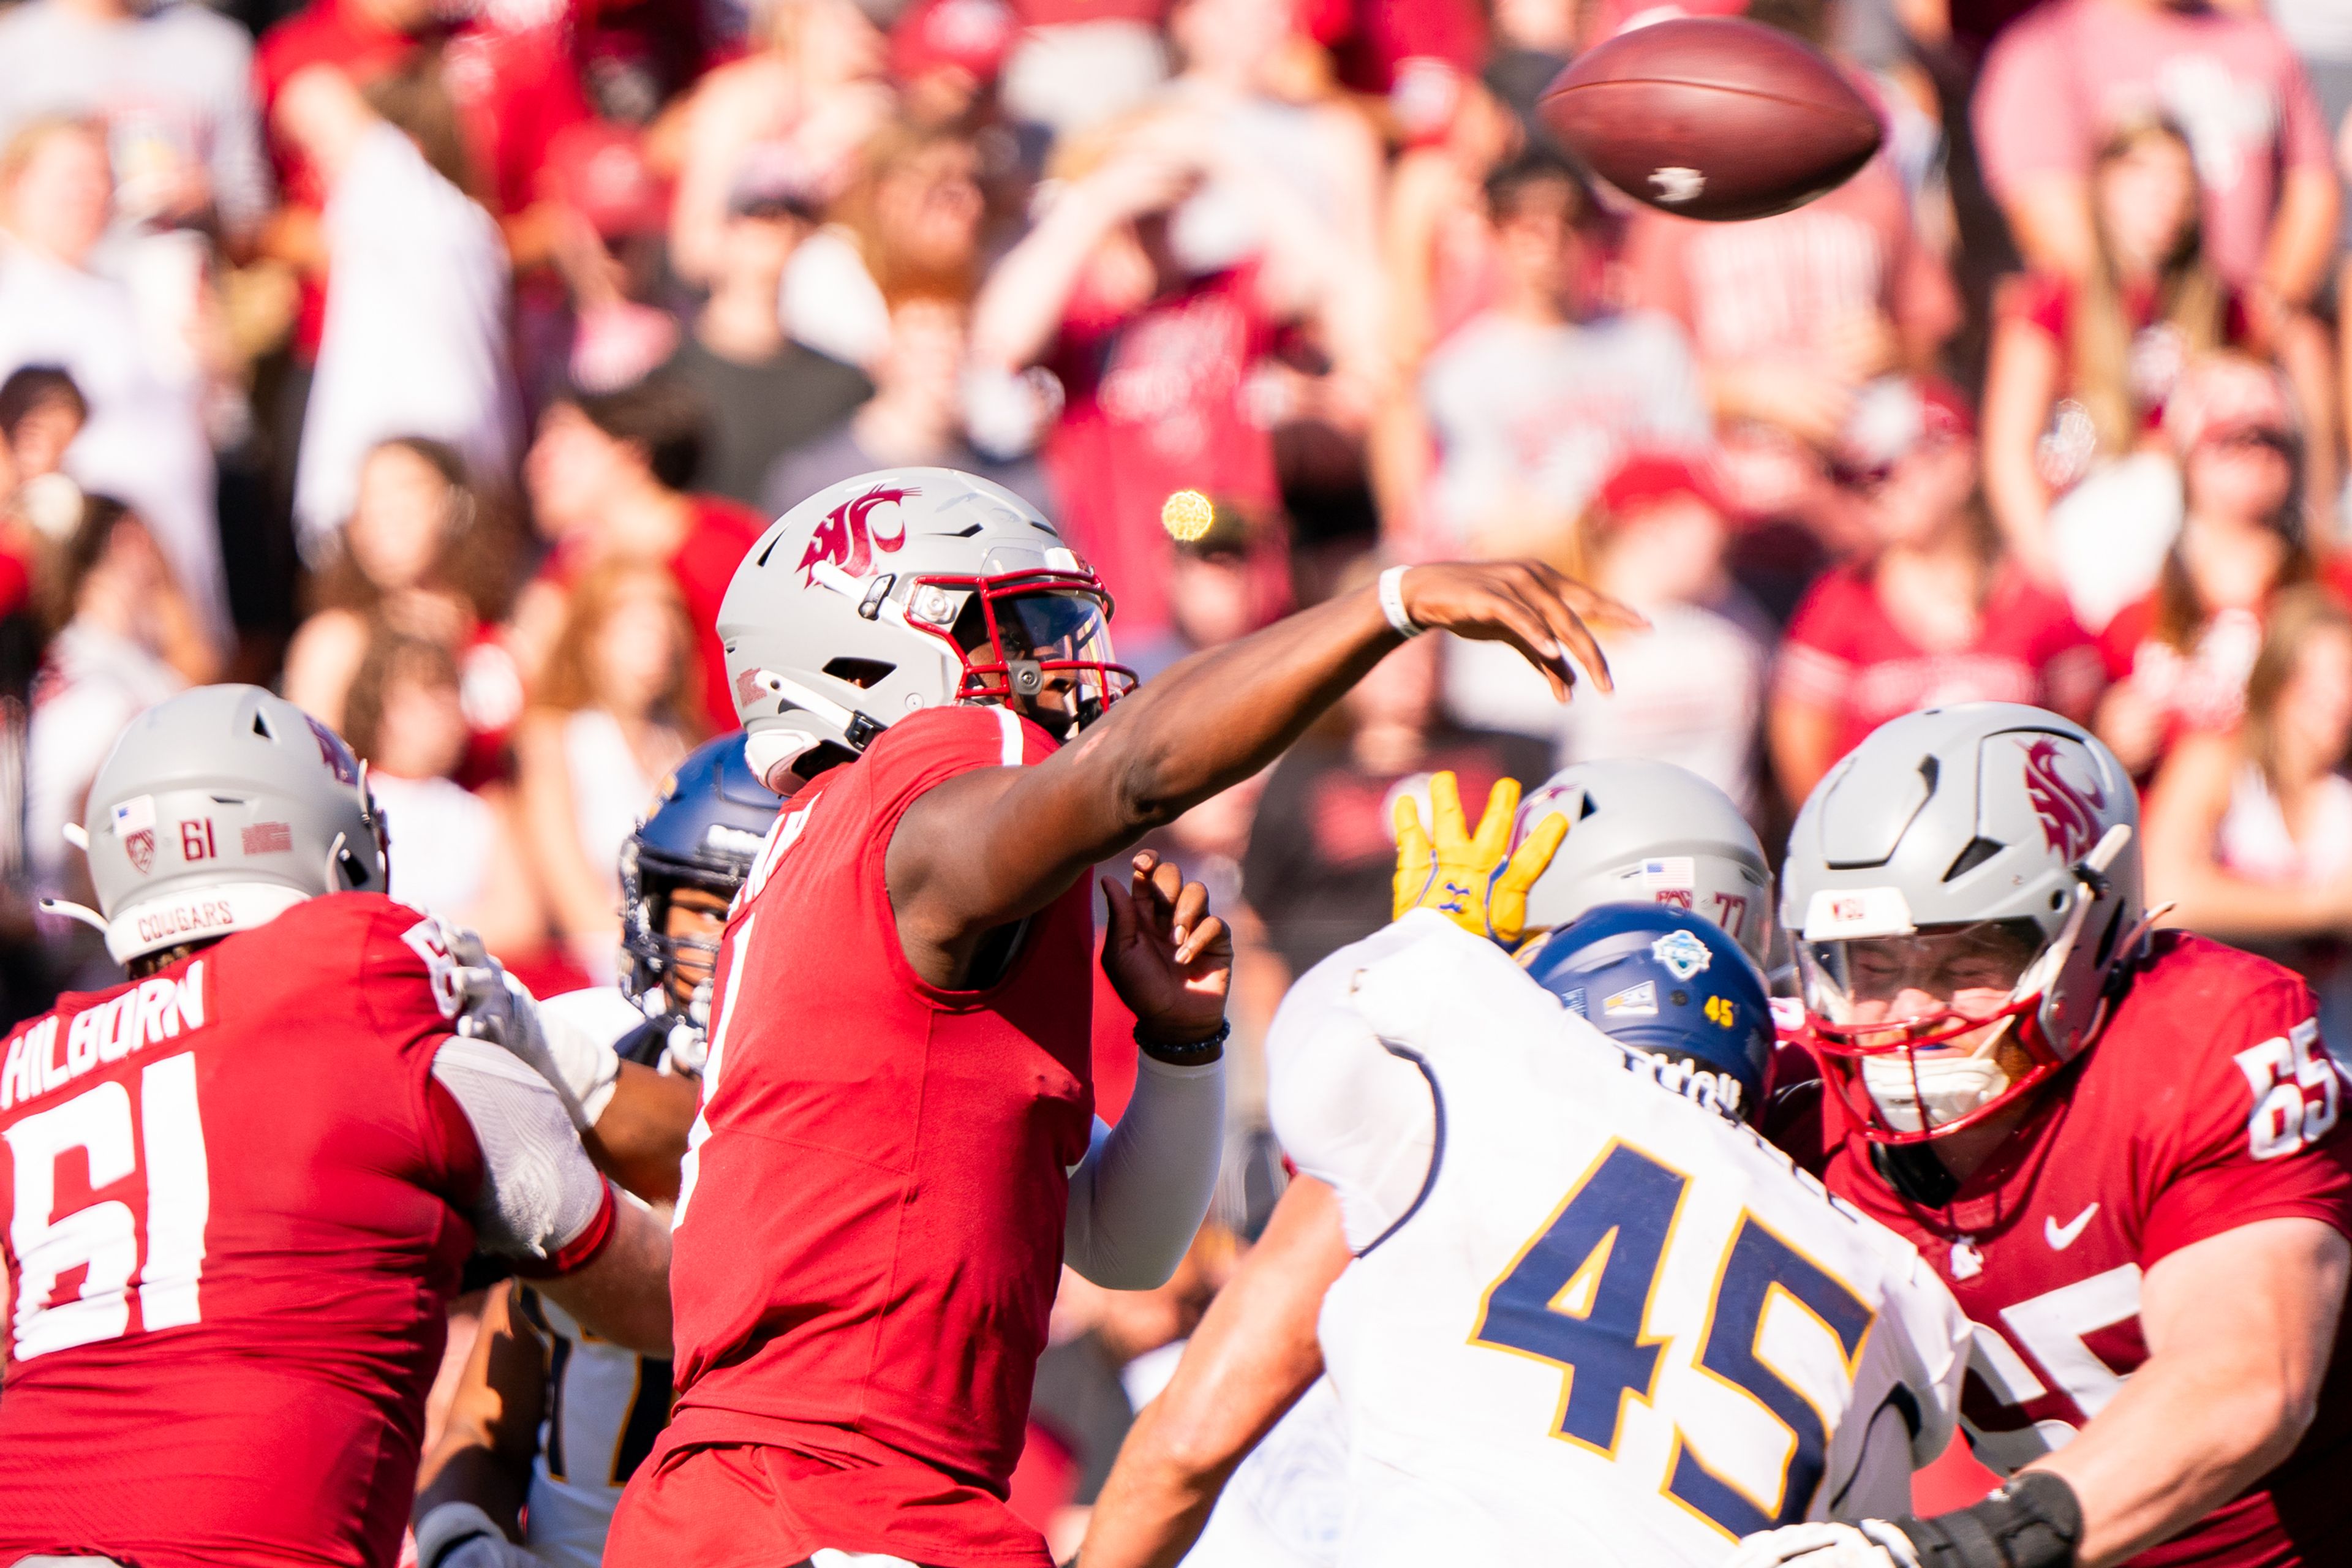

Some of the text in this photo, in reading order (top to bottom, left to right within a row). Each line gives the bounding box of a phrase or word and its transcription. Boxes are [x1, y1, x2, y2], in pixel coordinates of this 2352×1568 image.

[181, 818, 217, 862] 61
[137, 900, 234, 943] COUGARS
[1715, 891, 1747, 939] 77
[1, 959, 205, 1110] HILBORN
[1705, 995, 1734, 1028] 45
[2233, 1017, 2340, 1161] 65
[1, 1050, 210, 1362] 61
[1466, 1134, 1879, 1547] 45
